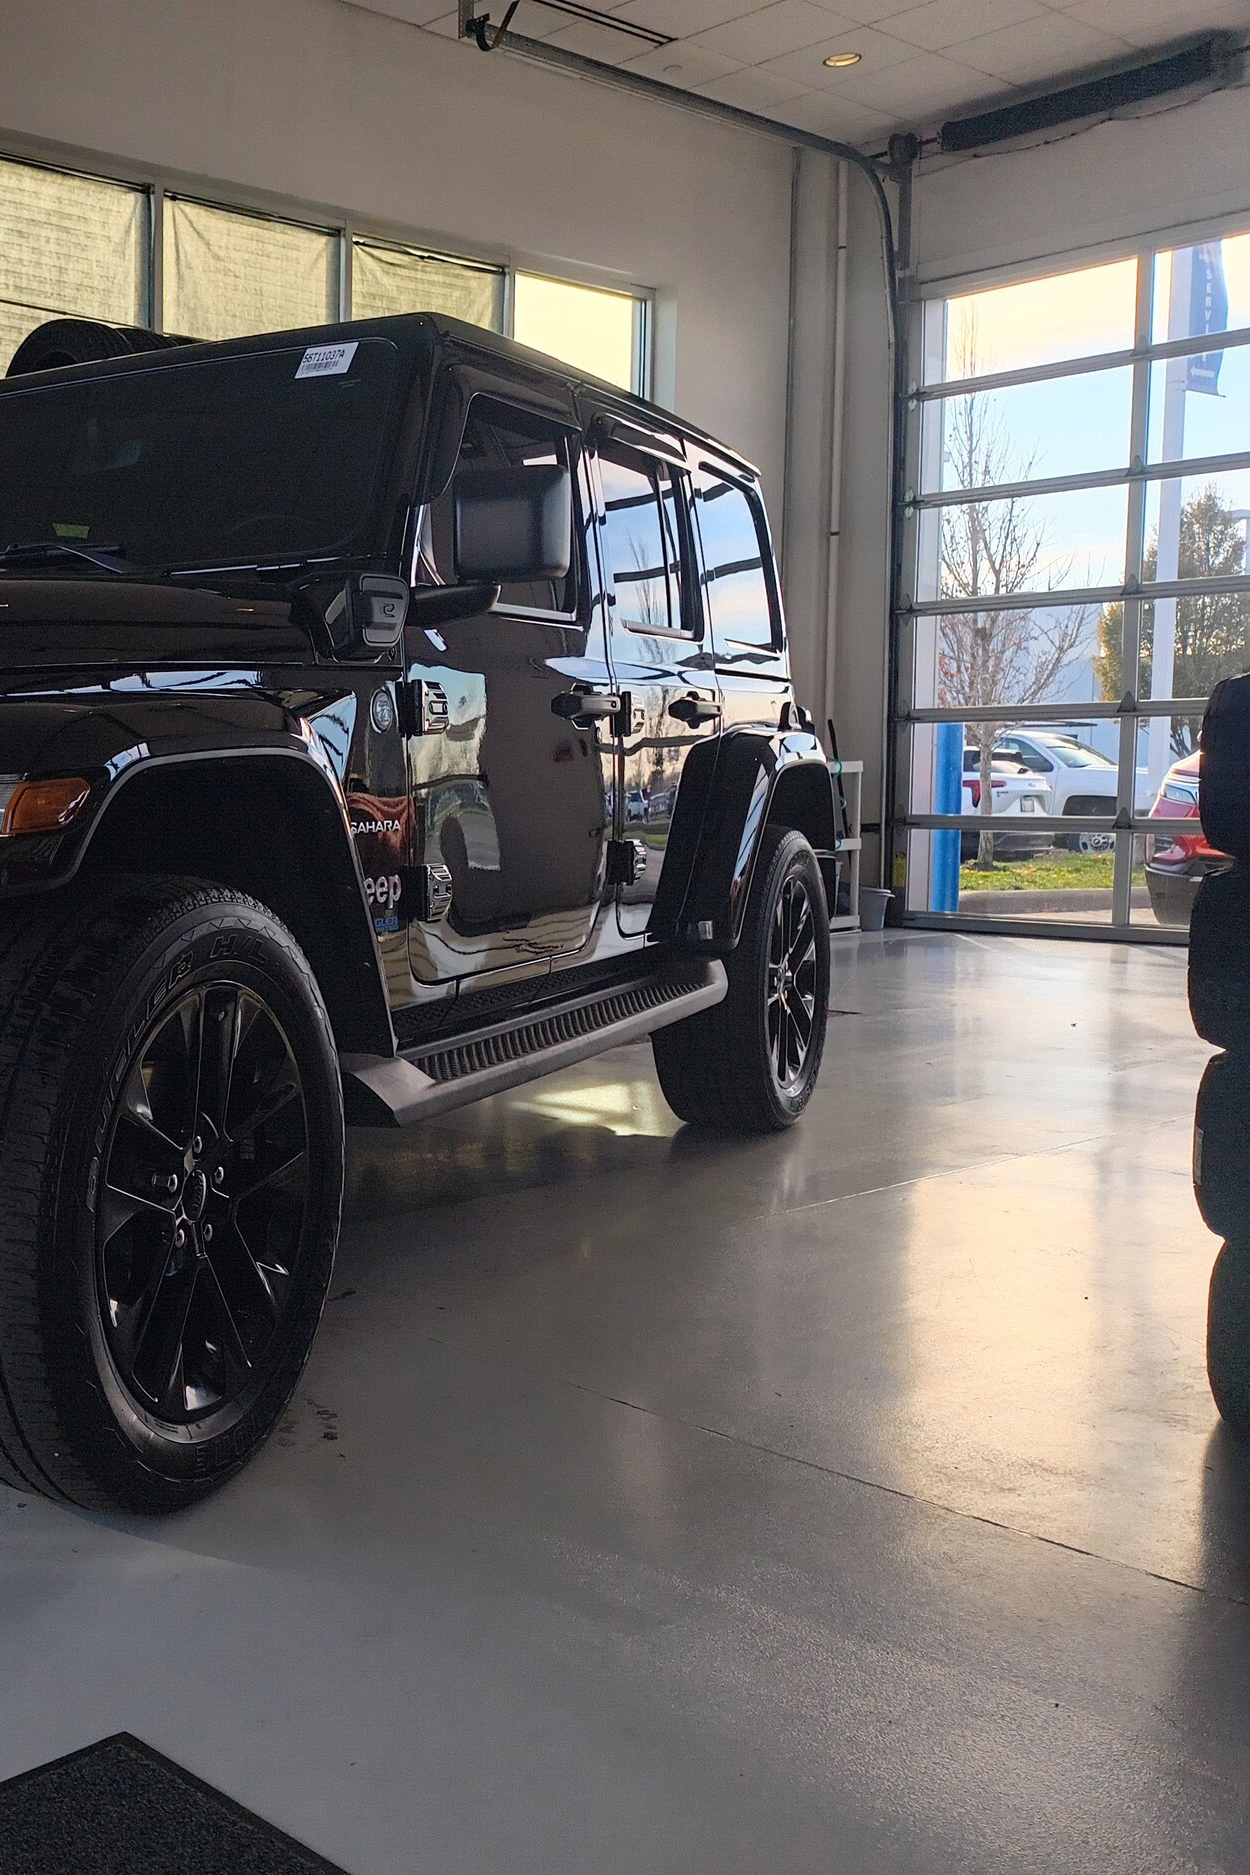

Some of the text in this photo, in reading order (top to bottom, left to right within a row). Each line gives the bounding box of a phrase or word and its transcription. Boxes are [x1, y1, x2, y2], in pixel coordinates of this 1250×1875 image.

[1201, 269, 1213, 363] SERVIE
[350, 820, 401, 834] SAHARA
[363, 874, 402, 909] eep
[374, 916, 399, 927] GLER
[85, 933, 272, 1214] DUELER H/L
